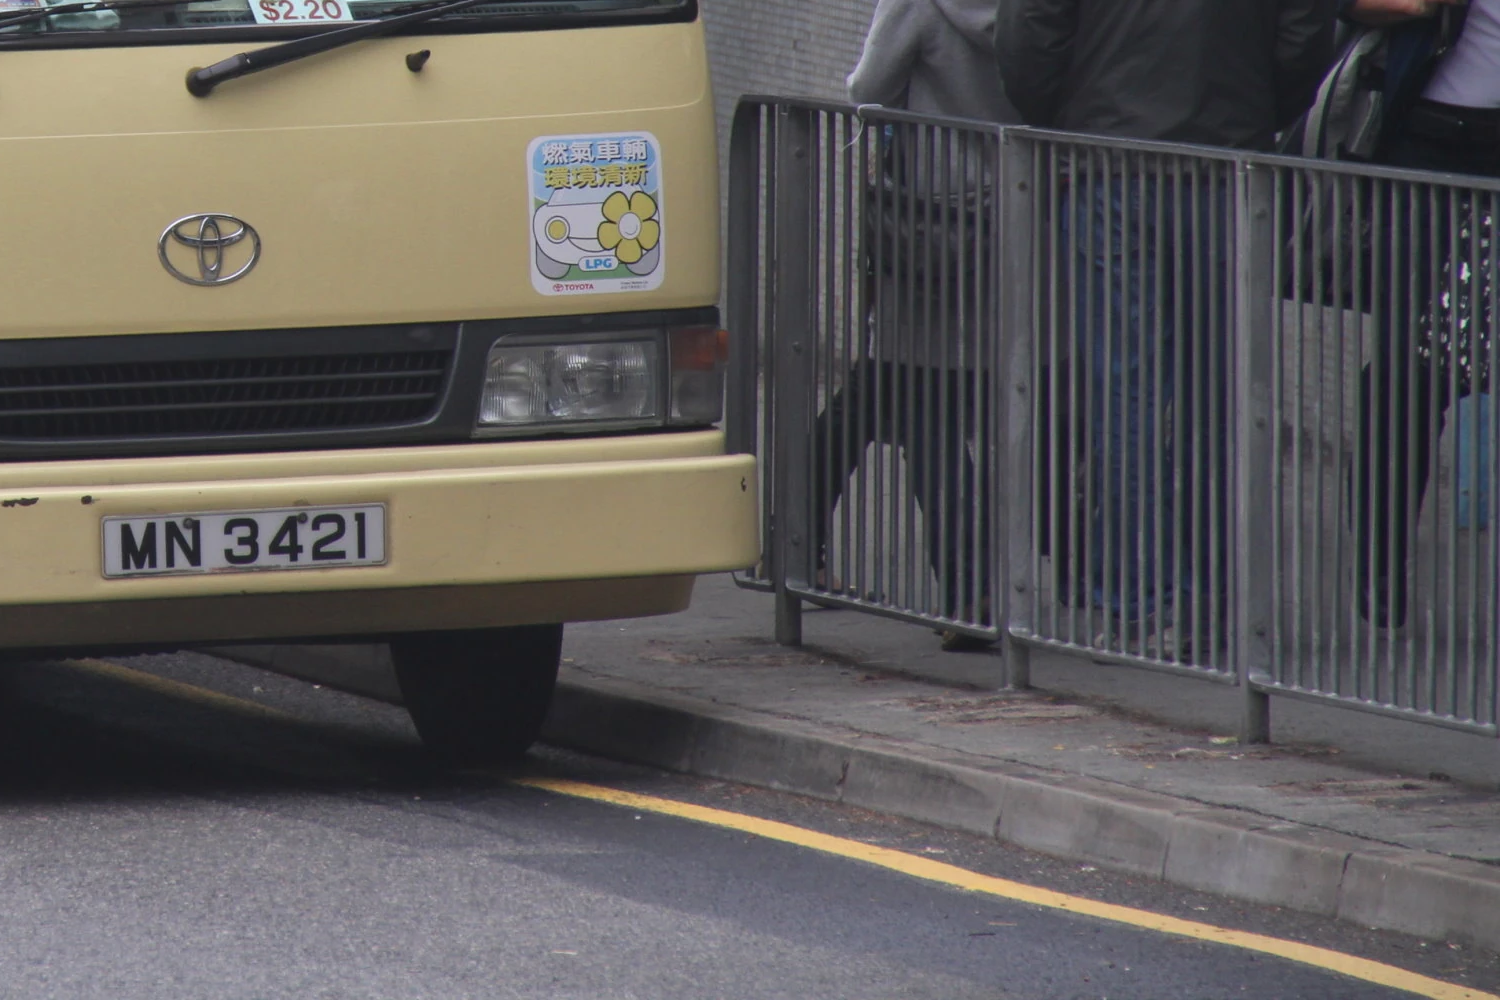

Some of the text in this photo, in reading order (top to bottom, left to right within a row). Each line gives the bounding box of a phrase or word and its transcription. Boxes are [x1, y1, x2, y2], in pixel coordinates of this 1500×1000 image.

[542, 138, 649, 166] 燃氣車輛
[544, 162, 649, 189] 環境清新
[585, 258, 613, 269] LPG
[565, 283, 595, 291] TOYOTA
[120, 511, 366, 570] MN 3421
